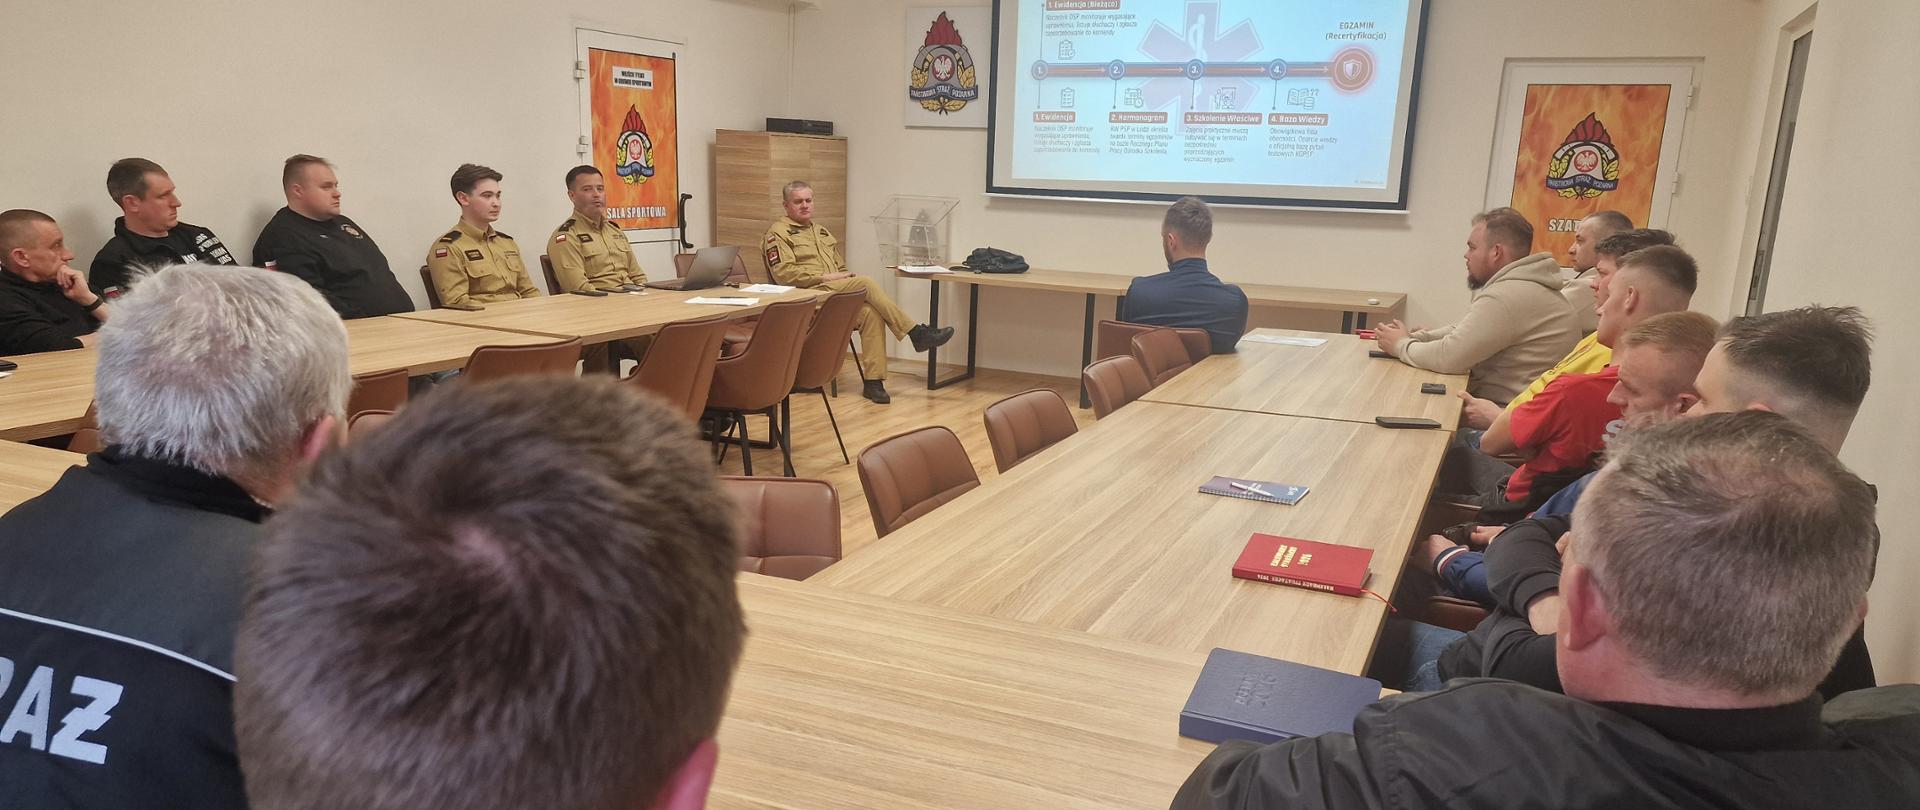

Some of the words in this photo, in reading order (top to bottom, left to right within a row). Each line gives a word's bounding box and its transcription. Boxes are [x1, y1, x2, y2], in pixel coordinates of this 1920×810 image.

[1339, 22, 1375, 30] EGZAMIN
[1325, 32, 1387, 41] (Recertyfikacja)
[1113, 66, 1121, 74] 2.
[1191, 66, 1199, 74] 3.
[1273, 66, 1282, 74] 4.
[1041, 113, 1073, 121] Ewidencja
[1194, 114, 1227, 122] Szkolenie
[1298, 116, 1325, 124] Wiedzy
[607, 207, 626, 219] SALA
[627, 206, 667, 218] SPORTOWA
